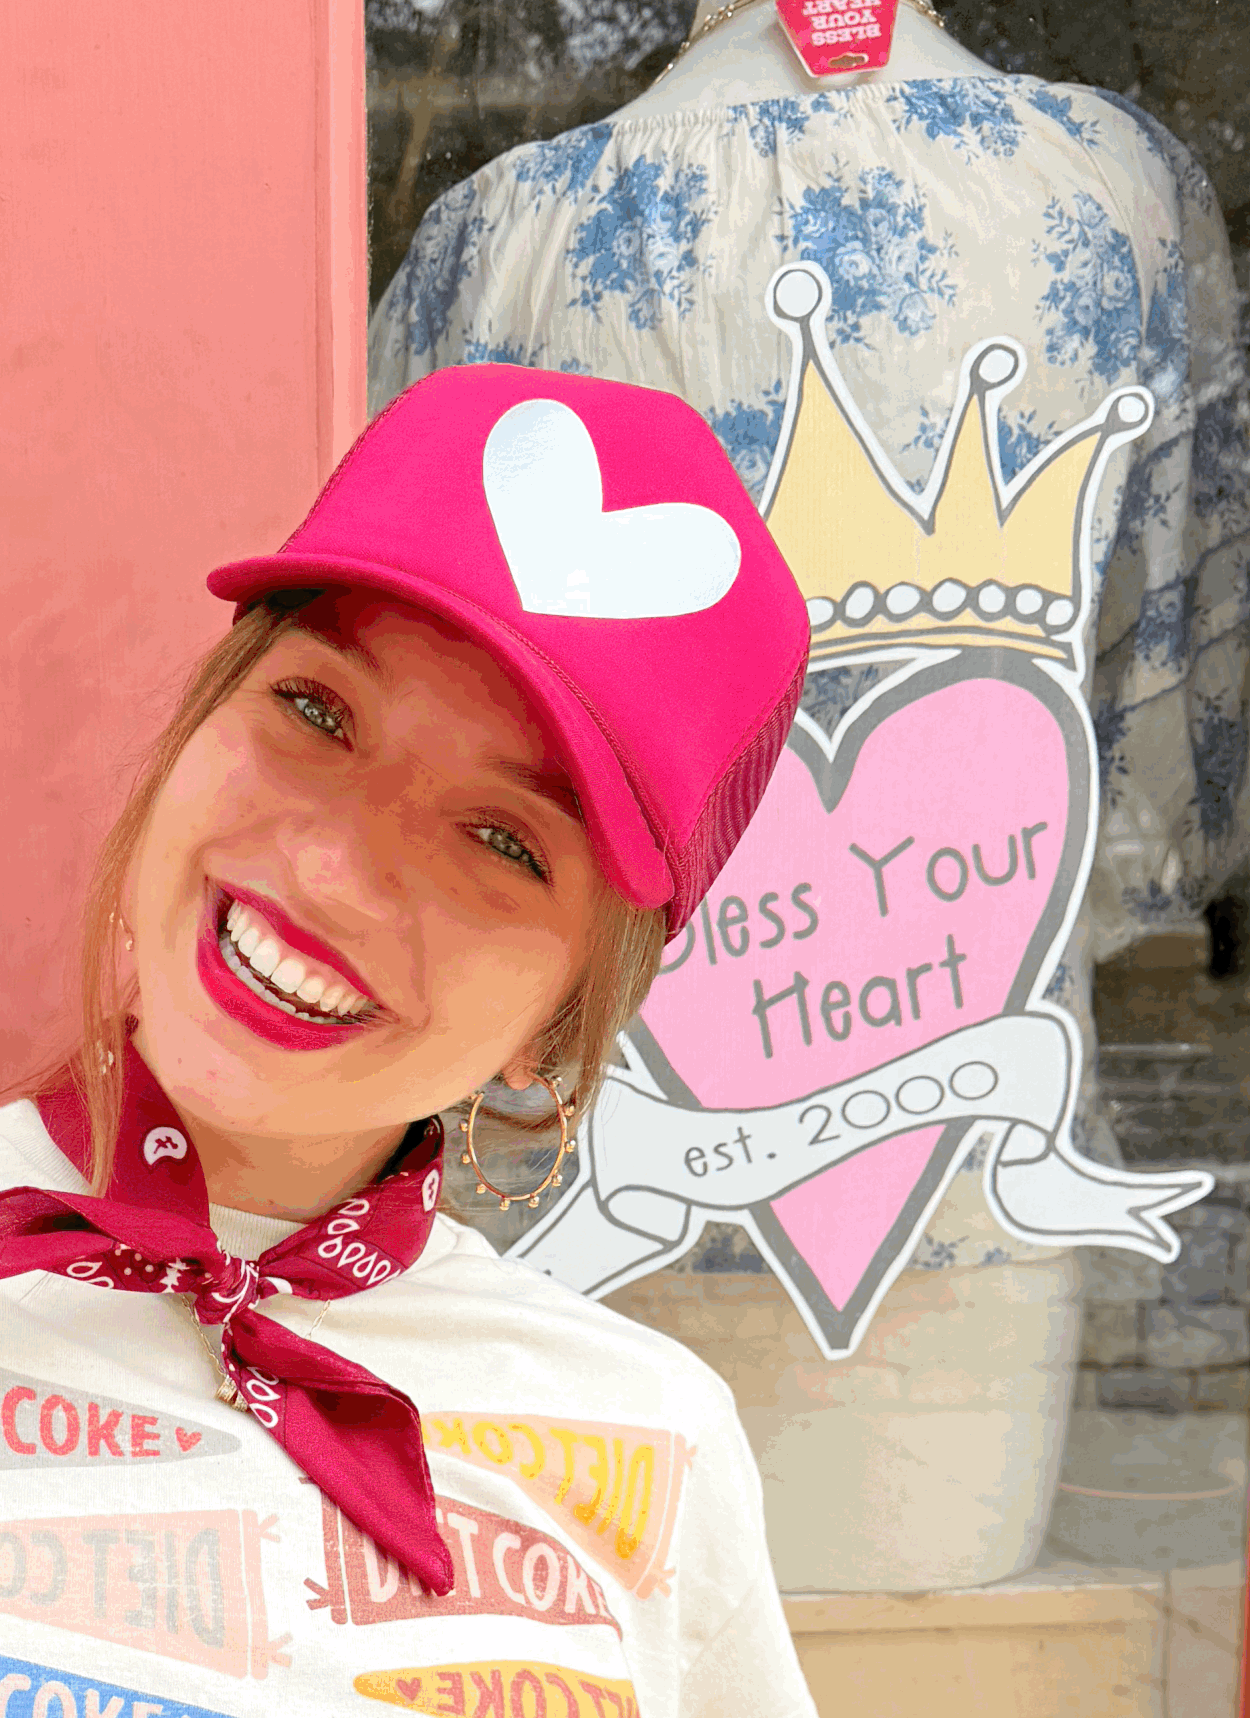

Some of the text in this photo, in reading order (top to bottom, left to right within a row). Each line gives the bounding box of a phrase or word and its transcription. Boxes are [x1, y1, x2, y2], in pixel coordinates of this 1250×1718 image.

[811, 9, 876, 30] YOUR
[811, 24, 882, 46] BLESS
[850, 822, 1048, 917] Your
[752, 934, 967, 1059] Heart
[683, 1061, 998, 1178] est. 2000
[1, 1385, 161, 1458] COKE
